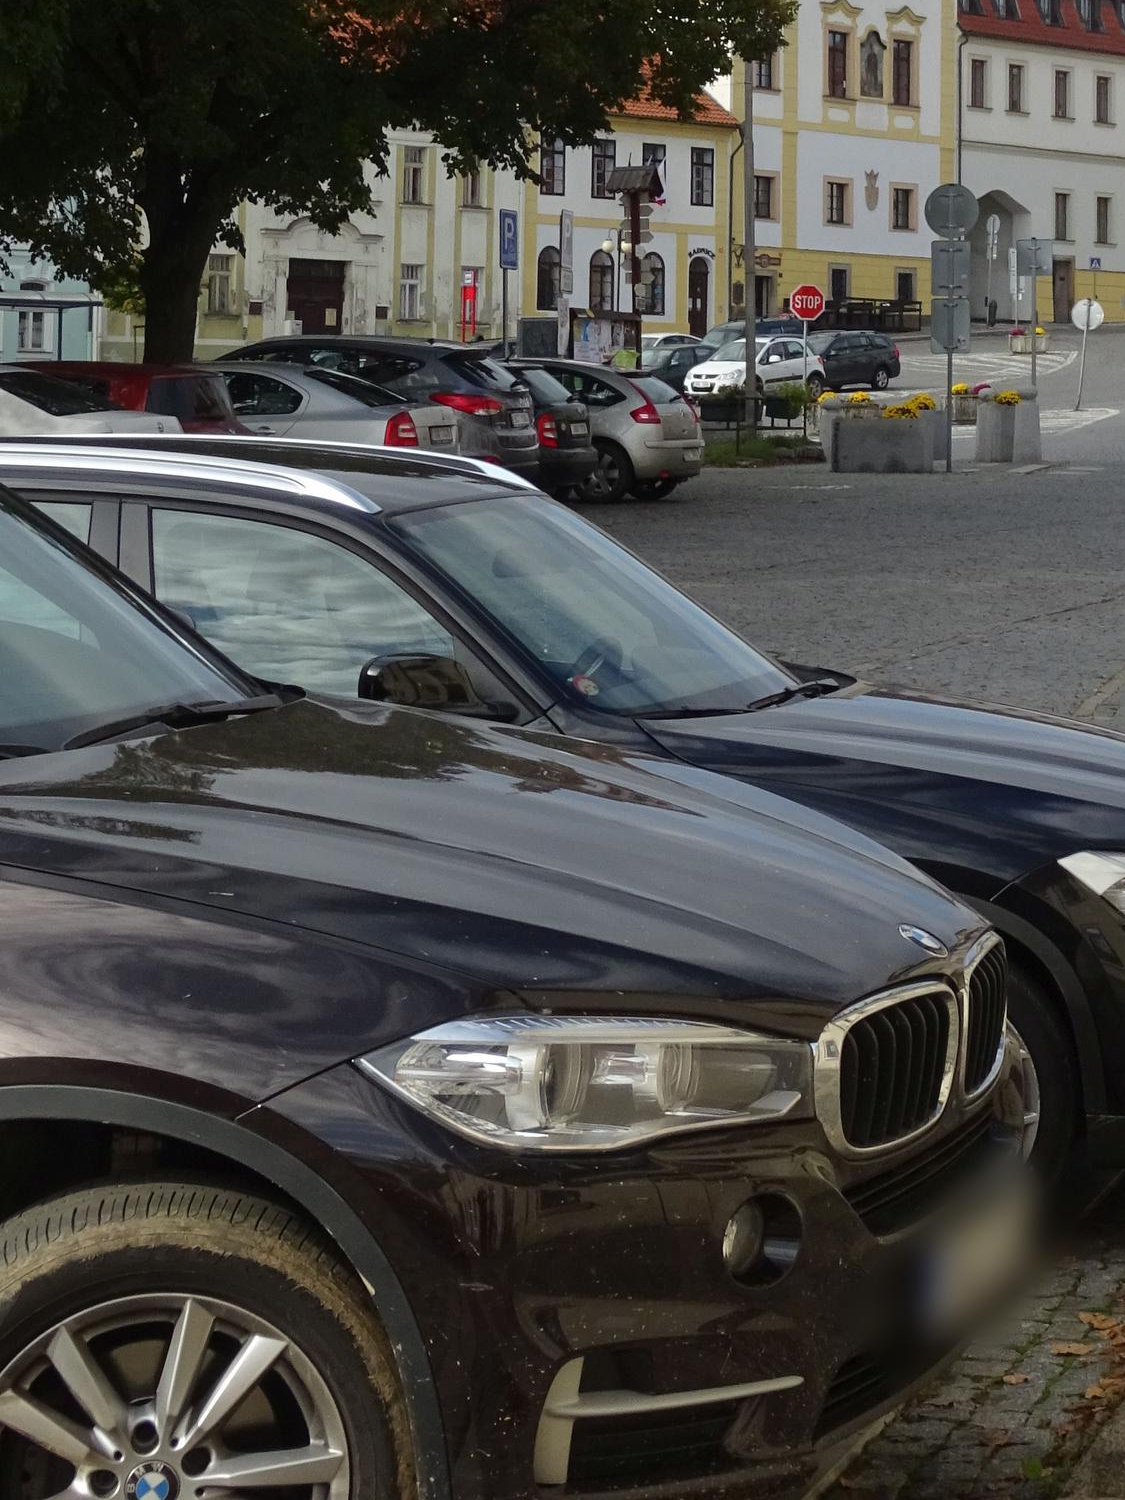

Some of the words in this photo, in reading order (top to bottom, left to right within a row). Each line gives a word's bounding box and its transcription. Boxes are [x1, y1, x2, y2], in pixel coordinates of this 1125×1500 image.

[504, 217, 515, 250] P
[564, 218, 572, 250] P
[794, 295, 821, 309] STOP
